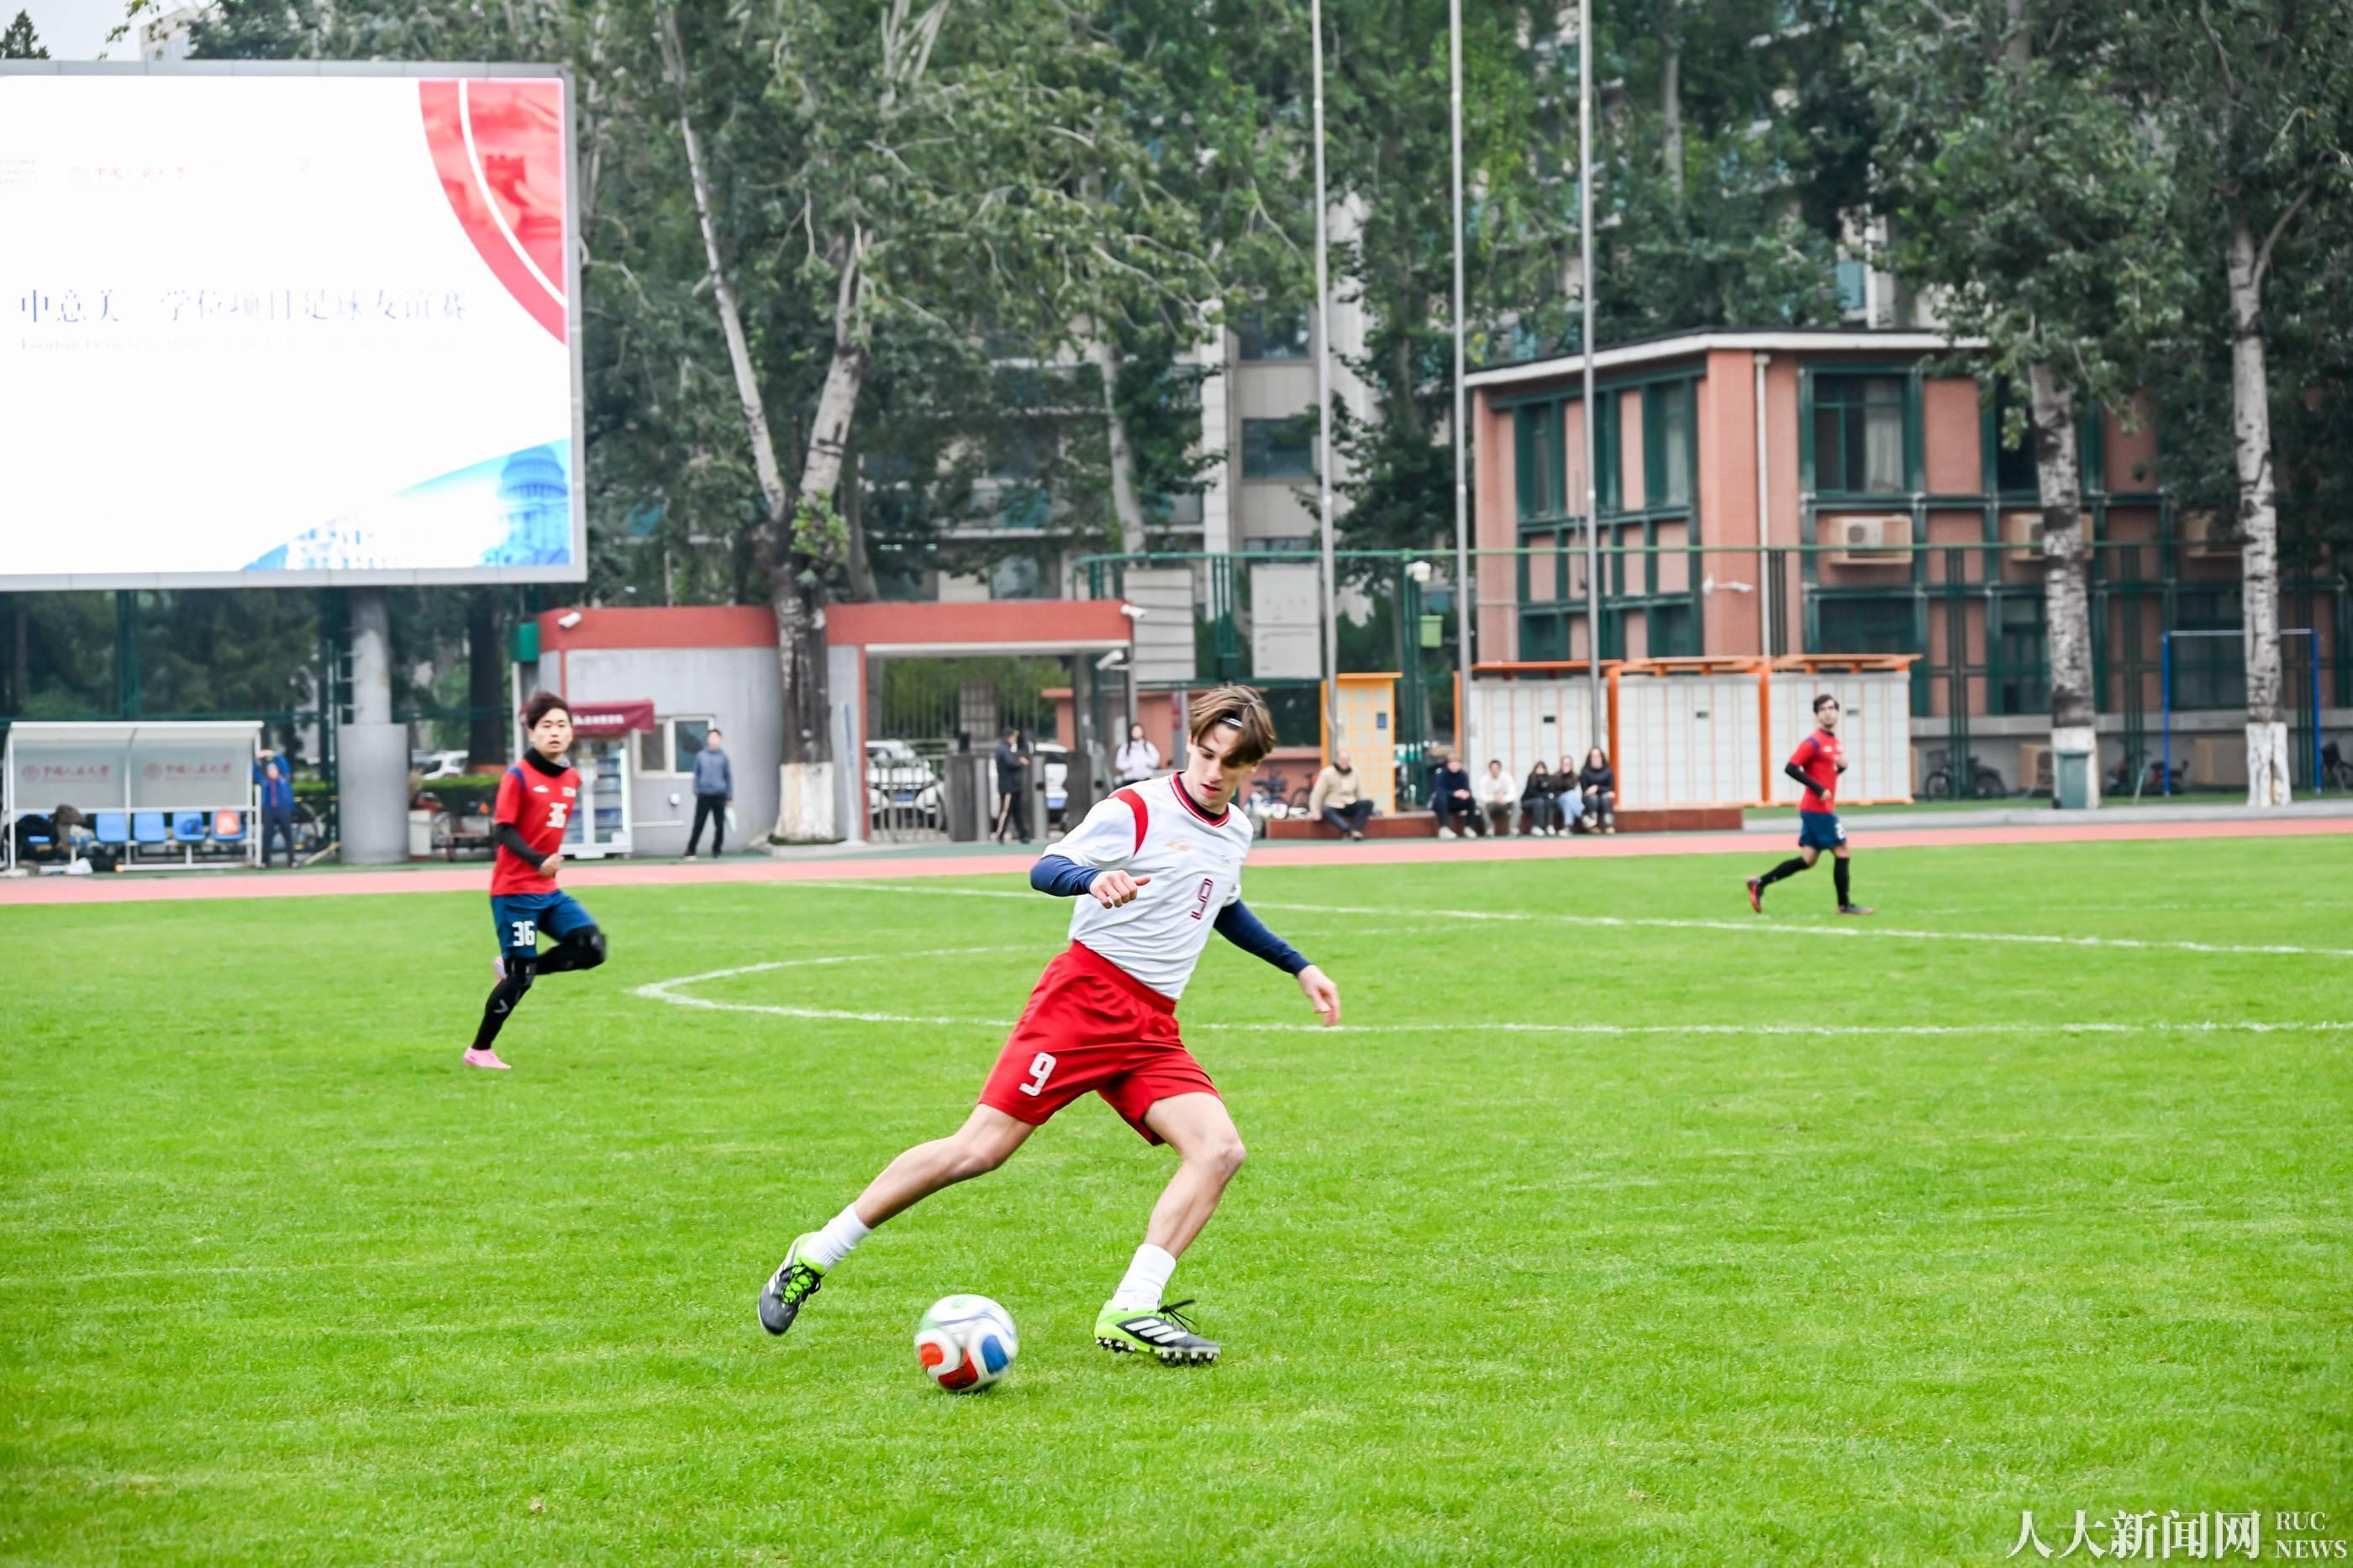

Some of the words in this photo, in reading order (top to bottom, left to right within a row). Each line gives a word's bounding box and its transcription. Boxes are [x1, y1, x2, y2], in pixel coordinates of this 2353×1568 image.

[1190, 878, 1214, 920] 9
[511, 920, 536, 947] 36
[1019, 1052, 1057, 1097] 9
